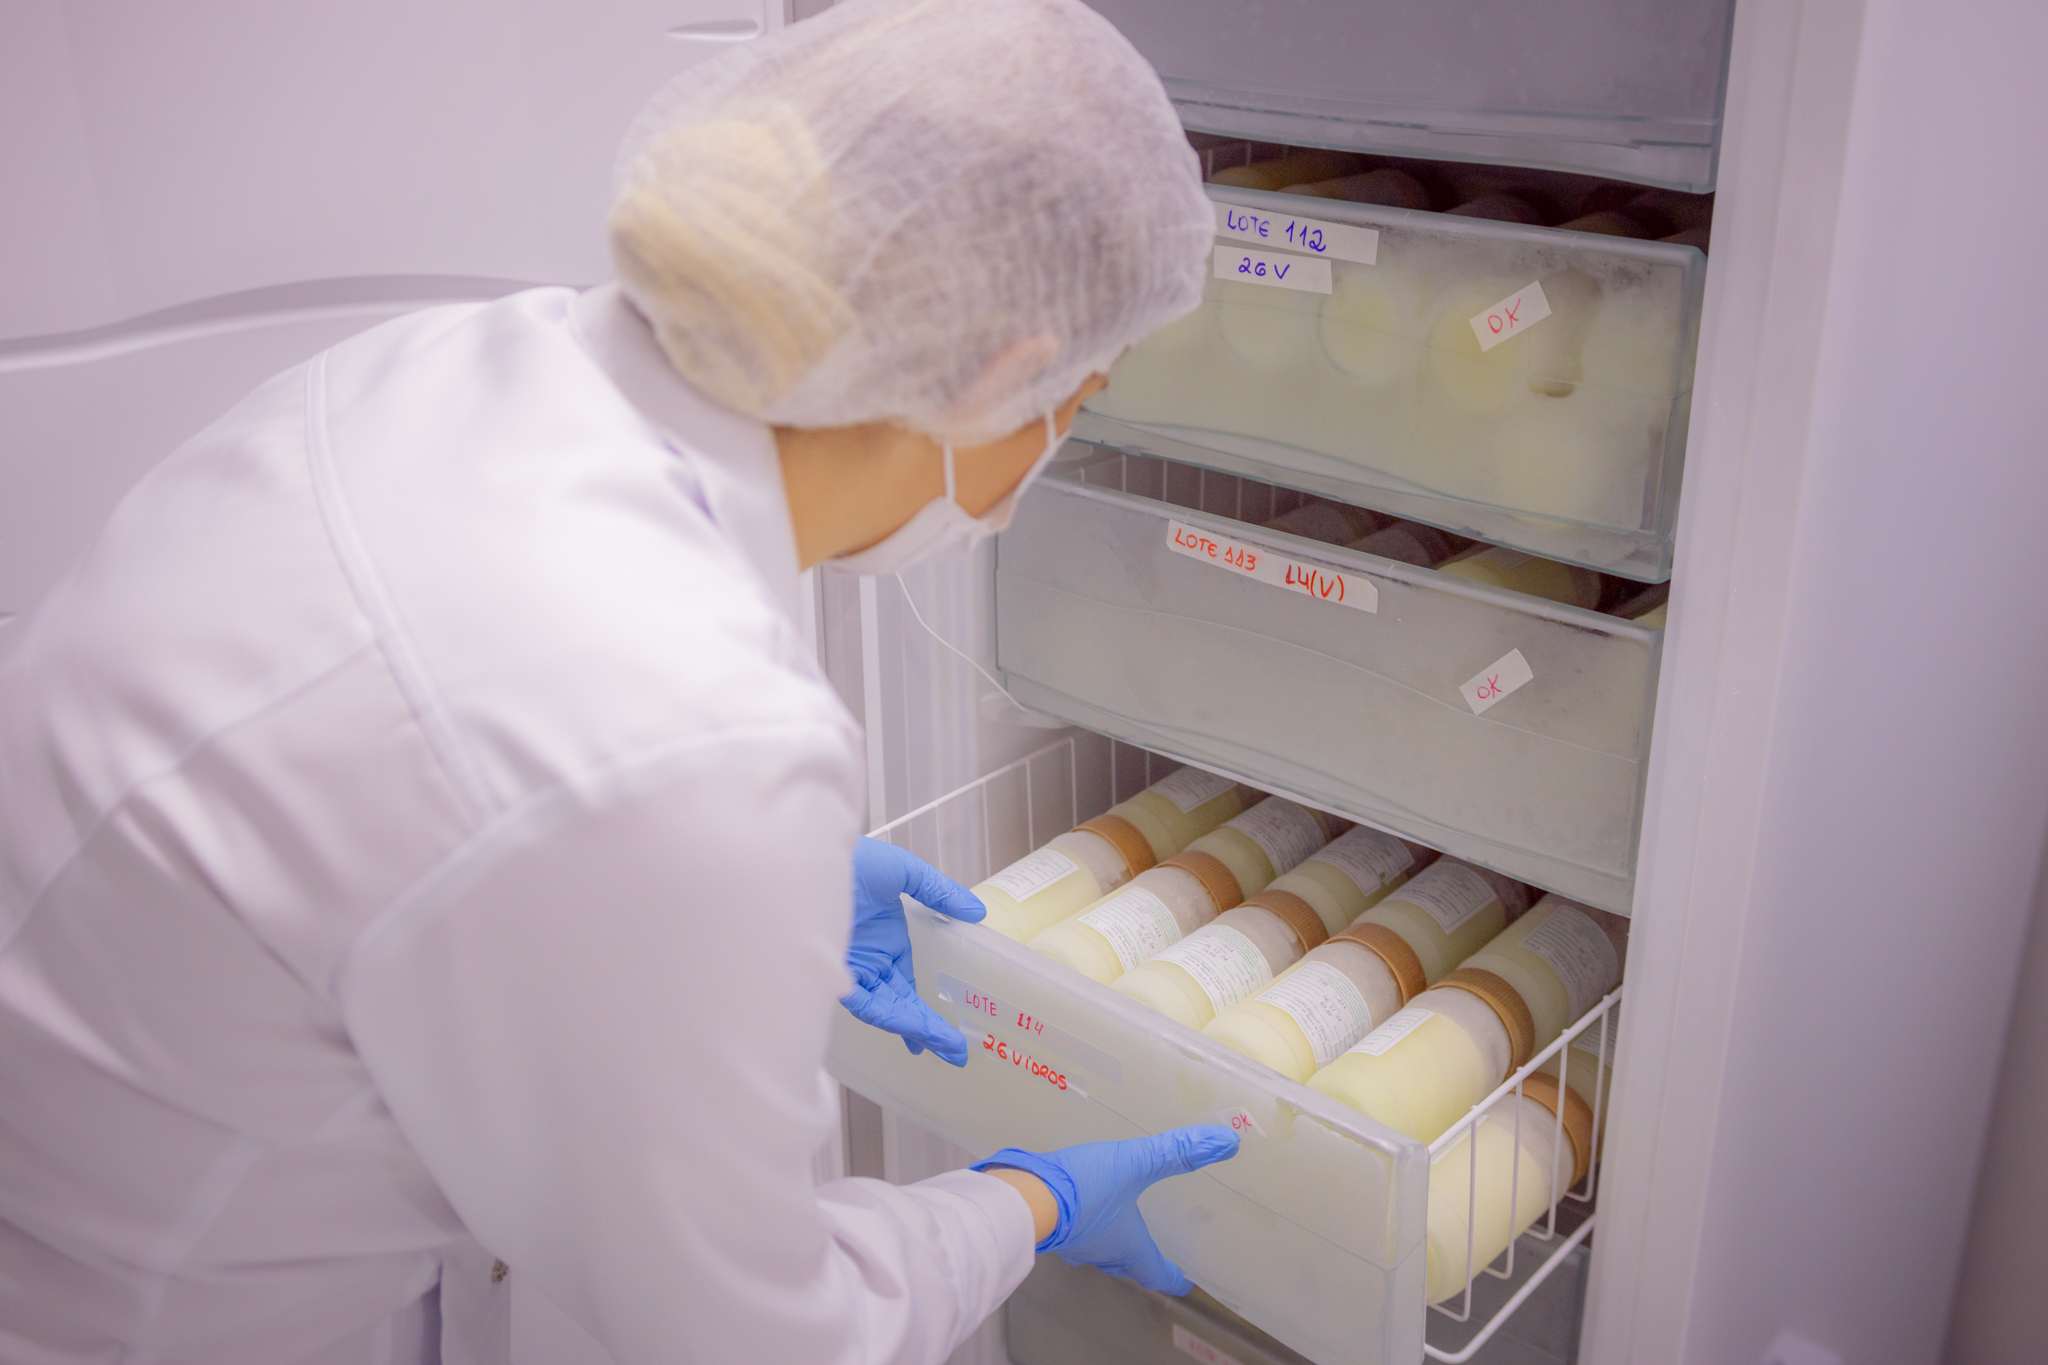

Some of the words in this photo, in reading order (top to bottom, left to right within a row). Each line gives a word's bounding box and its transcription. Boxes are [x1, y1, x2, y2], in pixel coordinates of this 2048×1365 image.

[1228, 210, 1270, 237] LOTE
[1285, 220, 1326, 252] 112
[1487, 298, 1521, 334] OK
[1175, 528, 1218, 557] LOTE
[1224, 546, 1257, 571] 113
[1477, 674, 1503, 699] OK
[965, 989, 998, 1017] LOTE
[1016, 1013, 1044, 1036] 114
[1231, 1113, 1253, 1133] OK
